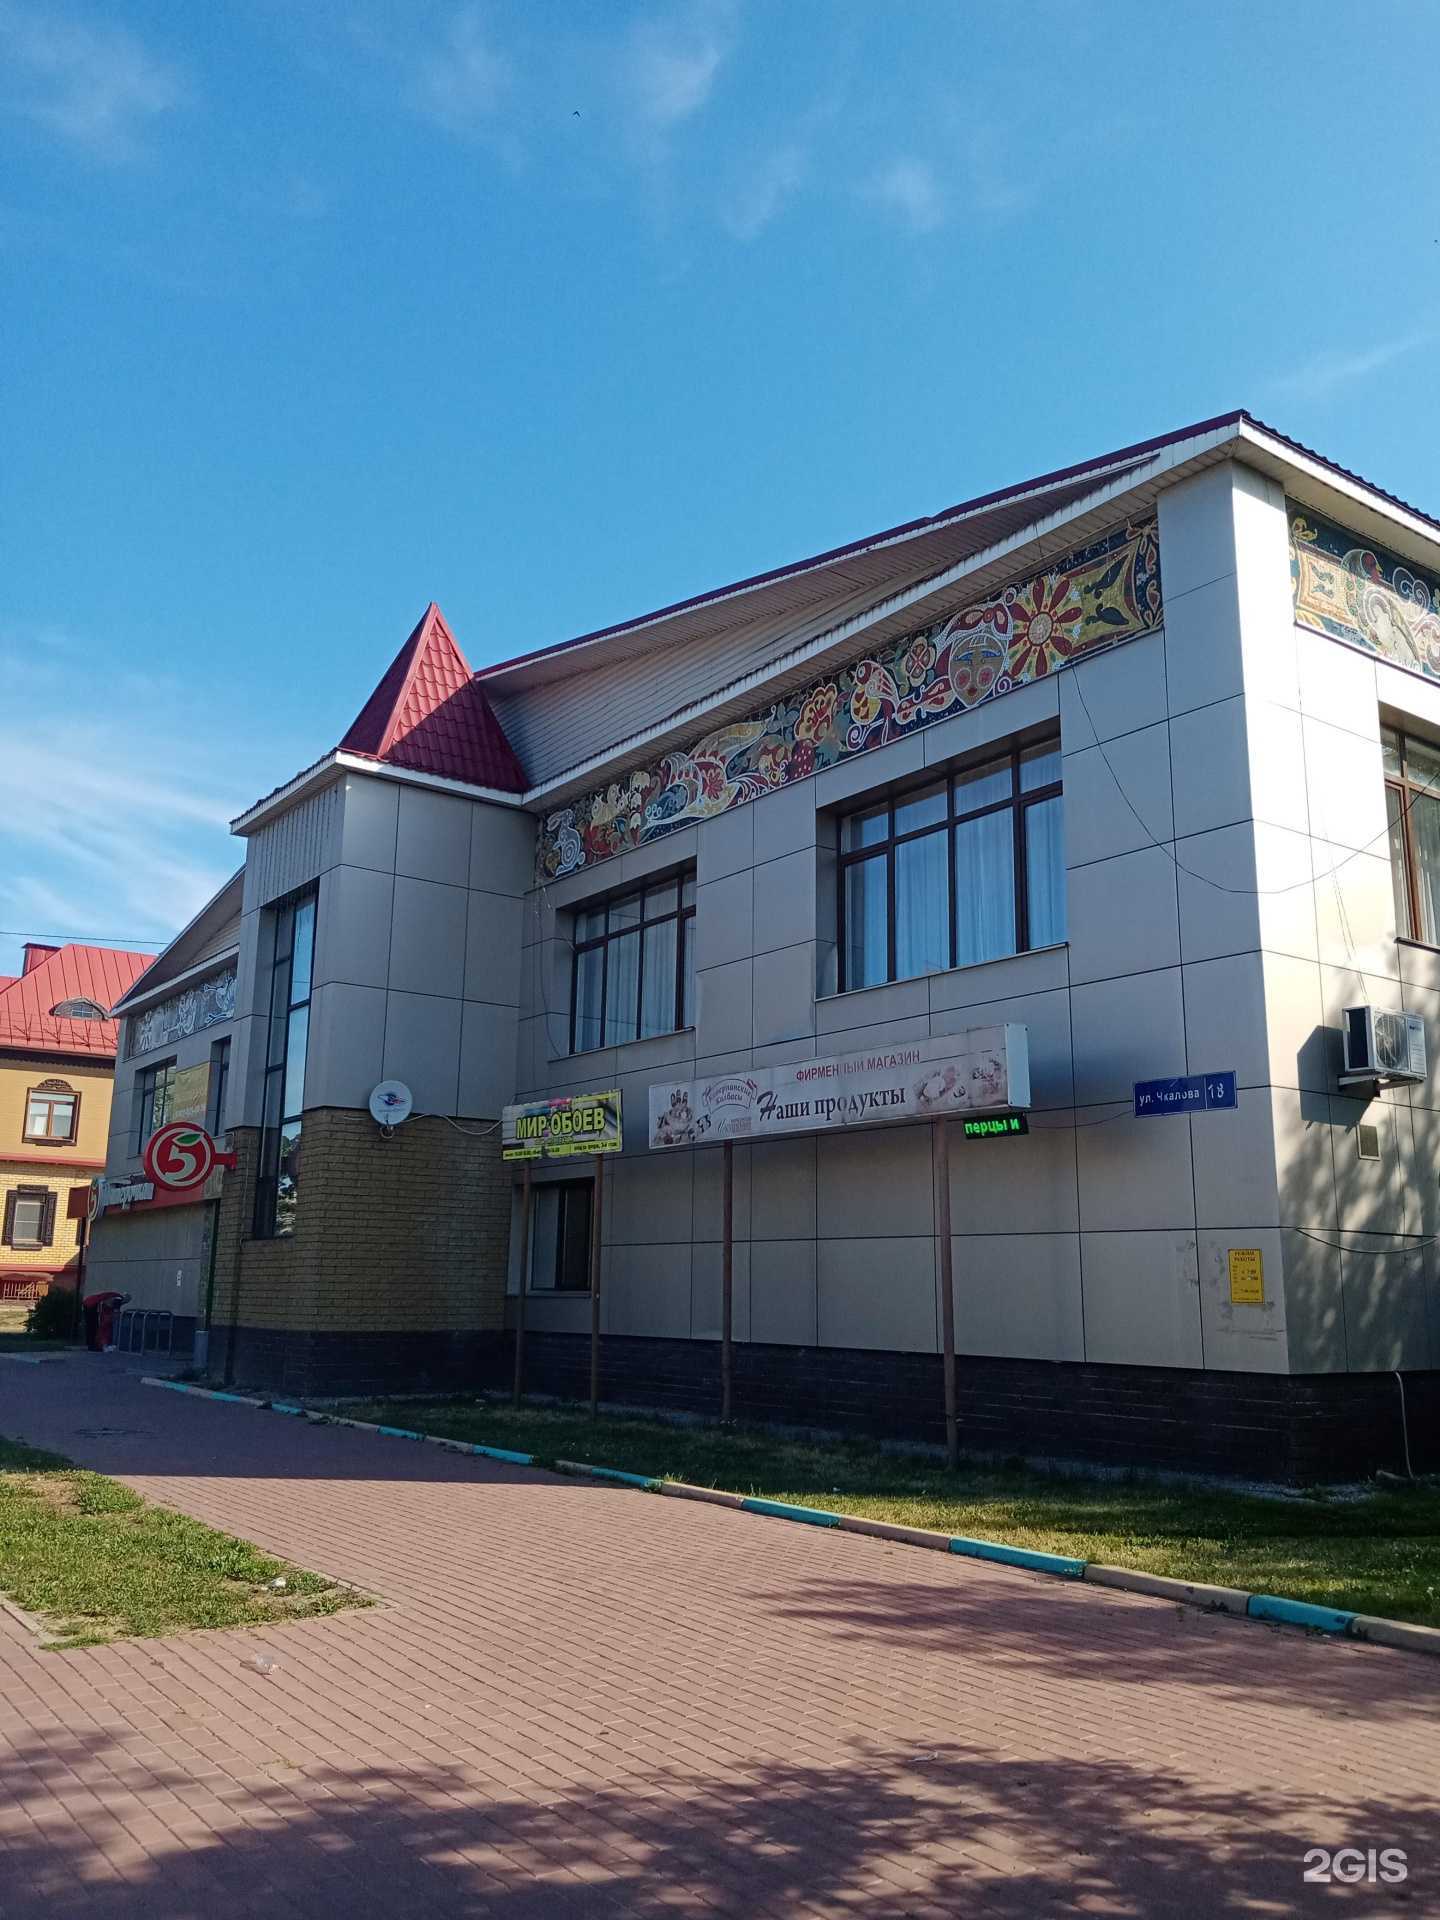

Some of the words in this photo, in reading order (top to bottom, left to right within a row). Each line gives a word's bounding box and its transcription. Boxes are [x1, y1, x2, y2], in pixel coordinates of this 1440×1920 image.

[867, 1050, 920, 1071] МАГАЗИН
[756, 1090, 810, 1122] Наши
[814, 1087, 906, 1121] продукты
[1139, 1095, 1154, 1107] ул.
[1156, 1089, 1200, 1102] Чкалова
[1207, 1082, 1225, 1099] 18
[516, 1115, 547, 1140] МИР
[550, 1107, 606, 1136] ОБОЕВ
[964, 1119, 1008, 1136] перцы
